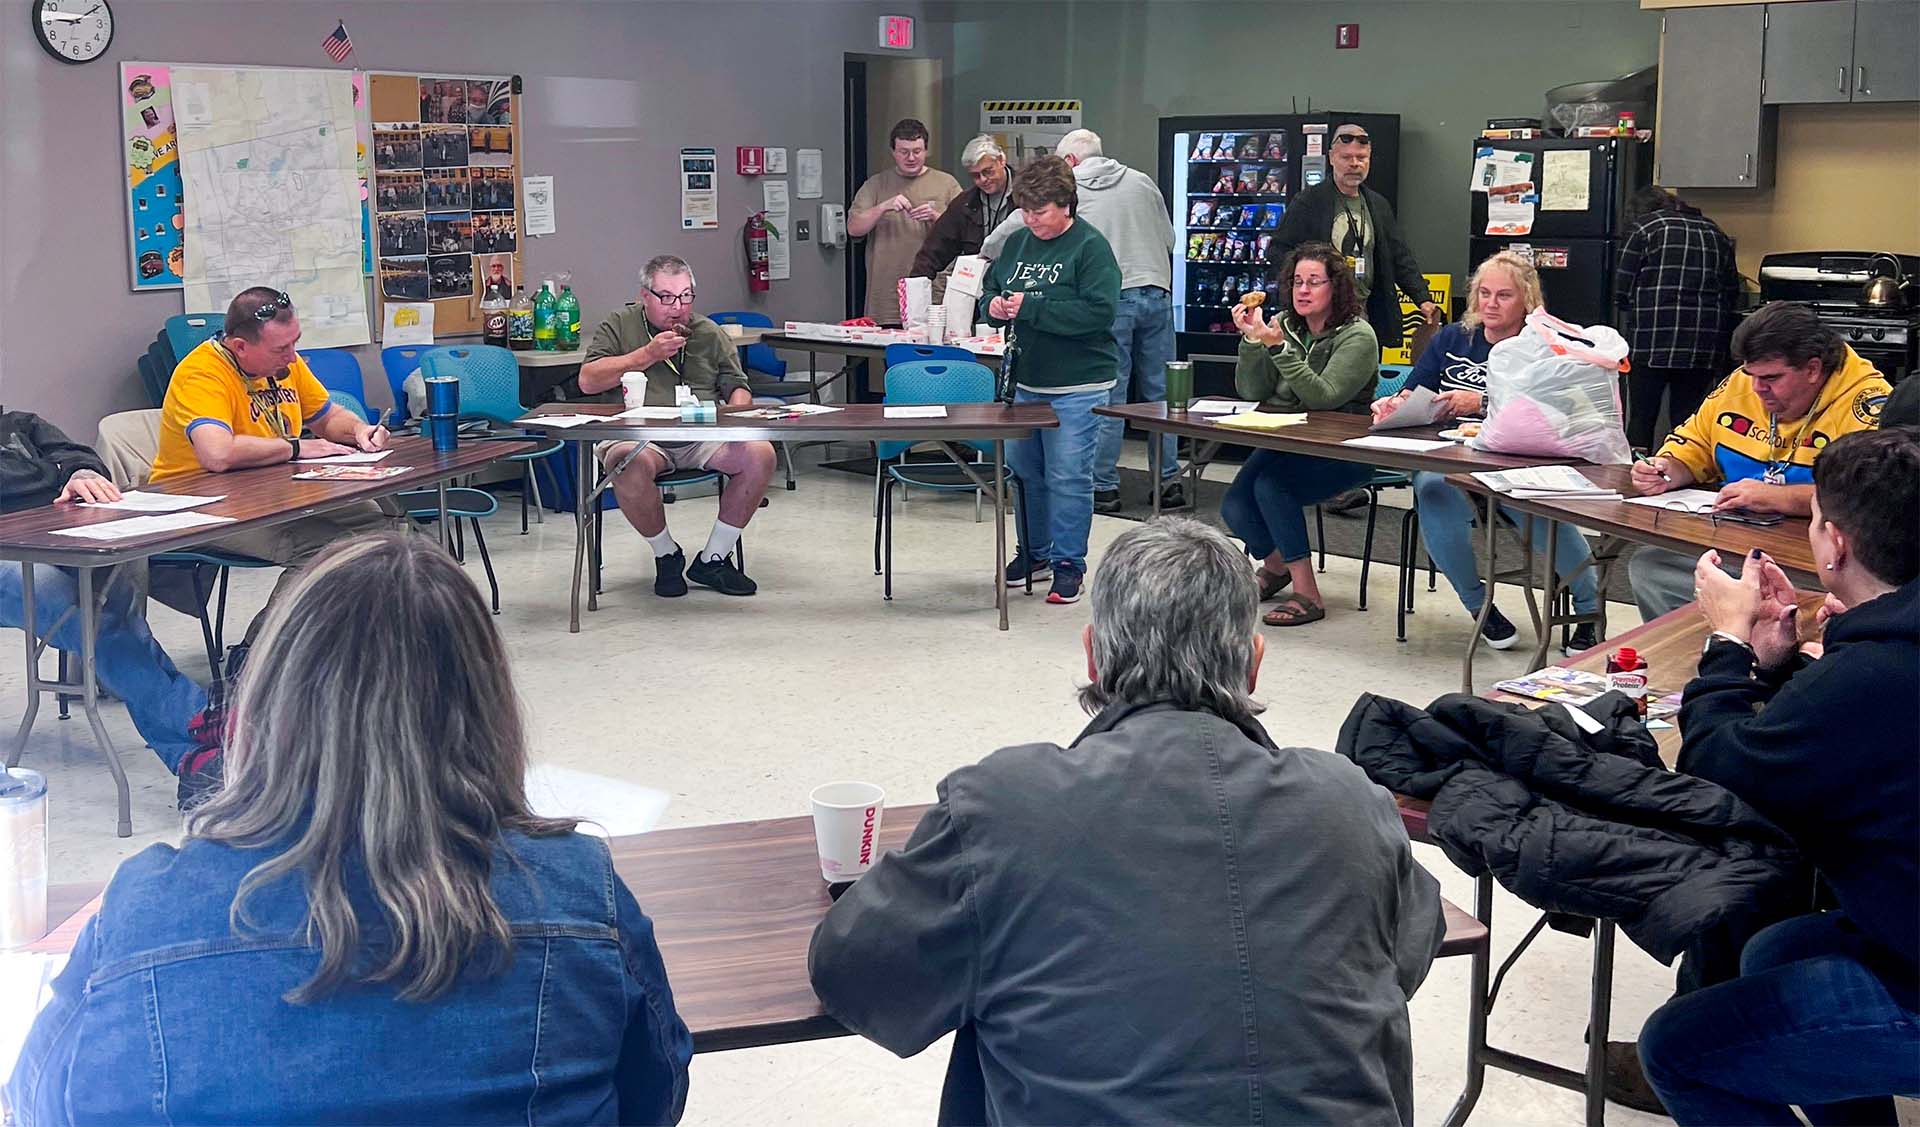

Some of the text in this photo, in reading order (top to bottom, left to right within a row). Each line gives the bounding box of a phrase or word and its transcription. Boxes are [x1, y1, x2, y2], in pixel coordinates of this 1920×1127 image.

[48, 2, 58, 12] 10
[96, 19, 103, 29] 3
[49, 30, 56, 40] 8
[94, 32, 100, 41] 4
[887, 17, 911, 47] EXIT
[61, 40, 67, 50] 7
[72, 45, 80, 55] 6
[85, 42, 92, 52] 5
[1006, 262, 1063, 285] JETS
[1749, 426, 1788, 449] SCHOL
